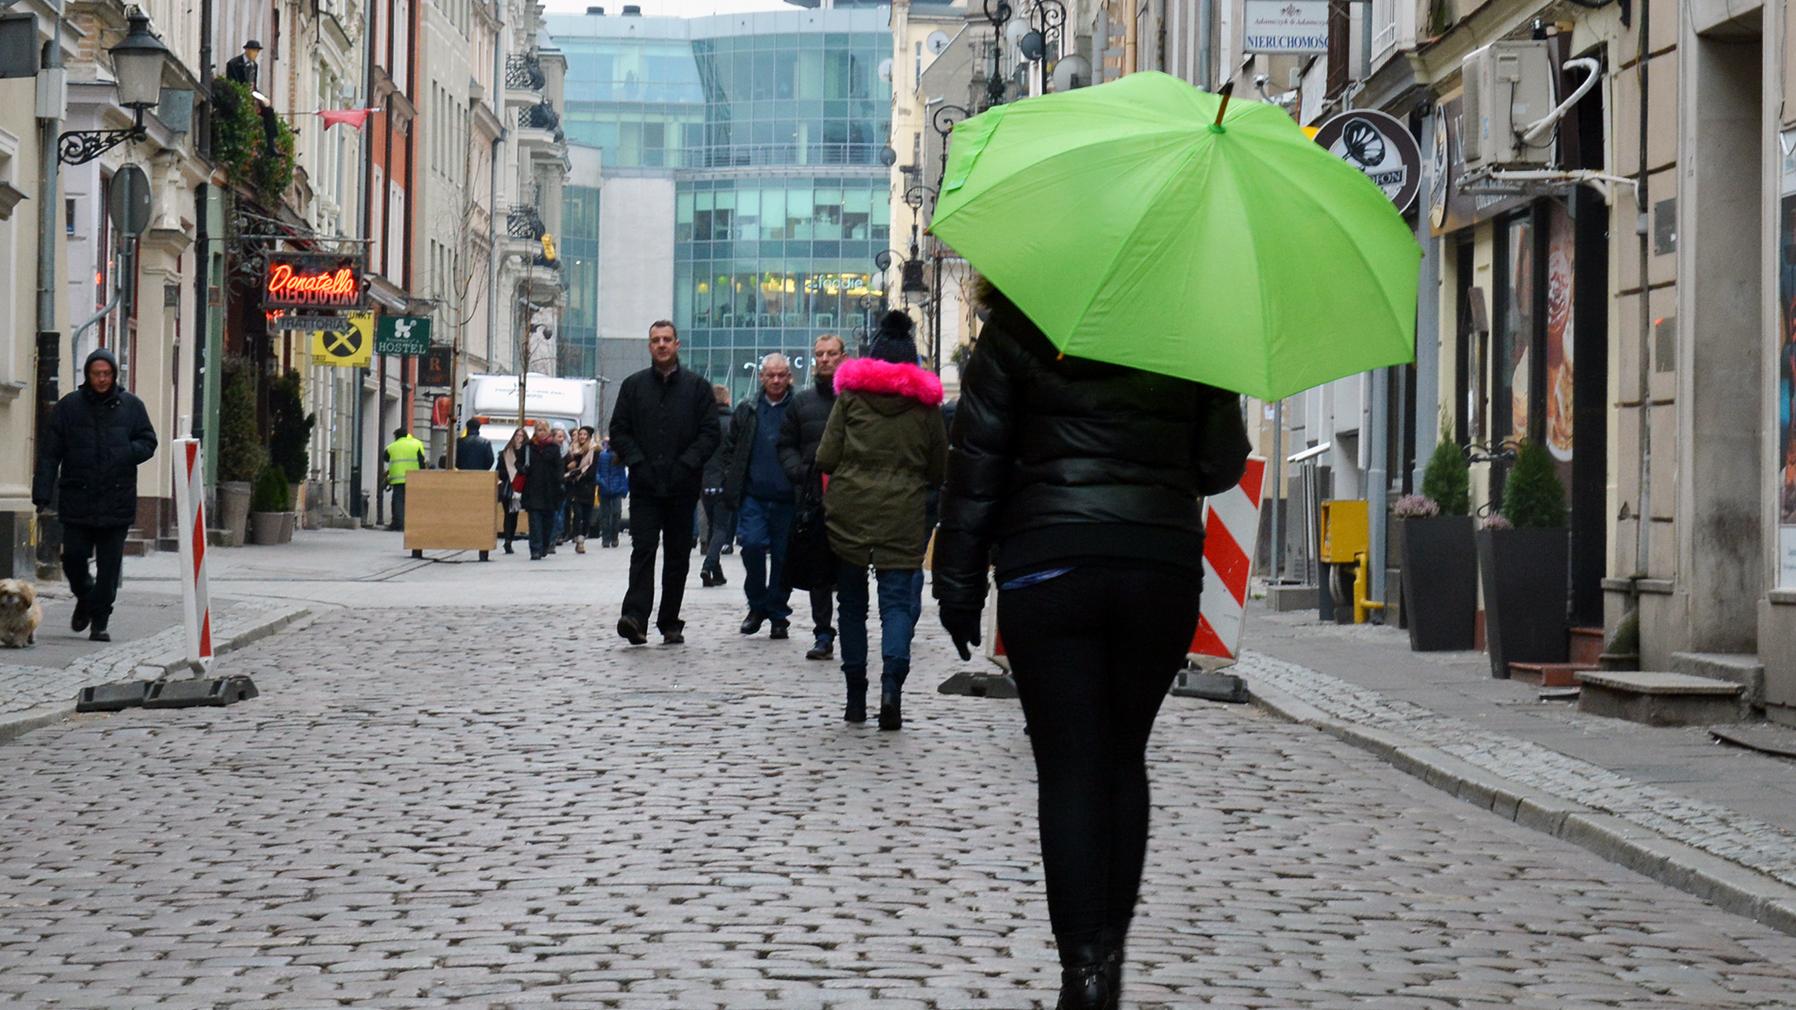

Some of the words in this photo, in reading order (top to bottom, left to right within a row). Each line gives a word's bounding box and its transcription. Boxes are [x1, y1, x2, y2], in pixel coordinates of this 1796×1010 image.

[268, 264, 354, 294] Donatello
[818, 274, 863, 289] foodie
[281, 317, 347, 330] TRATTORIA
[378, 342, 426, 354] HOSTEL
